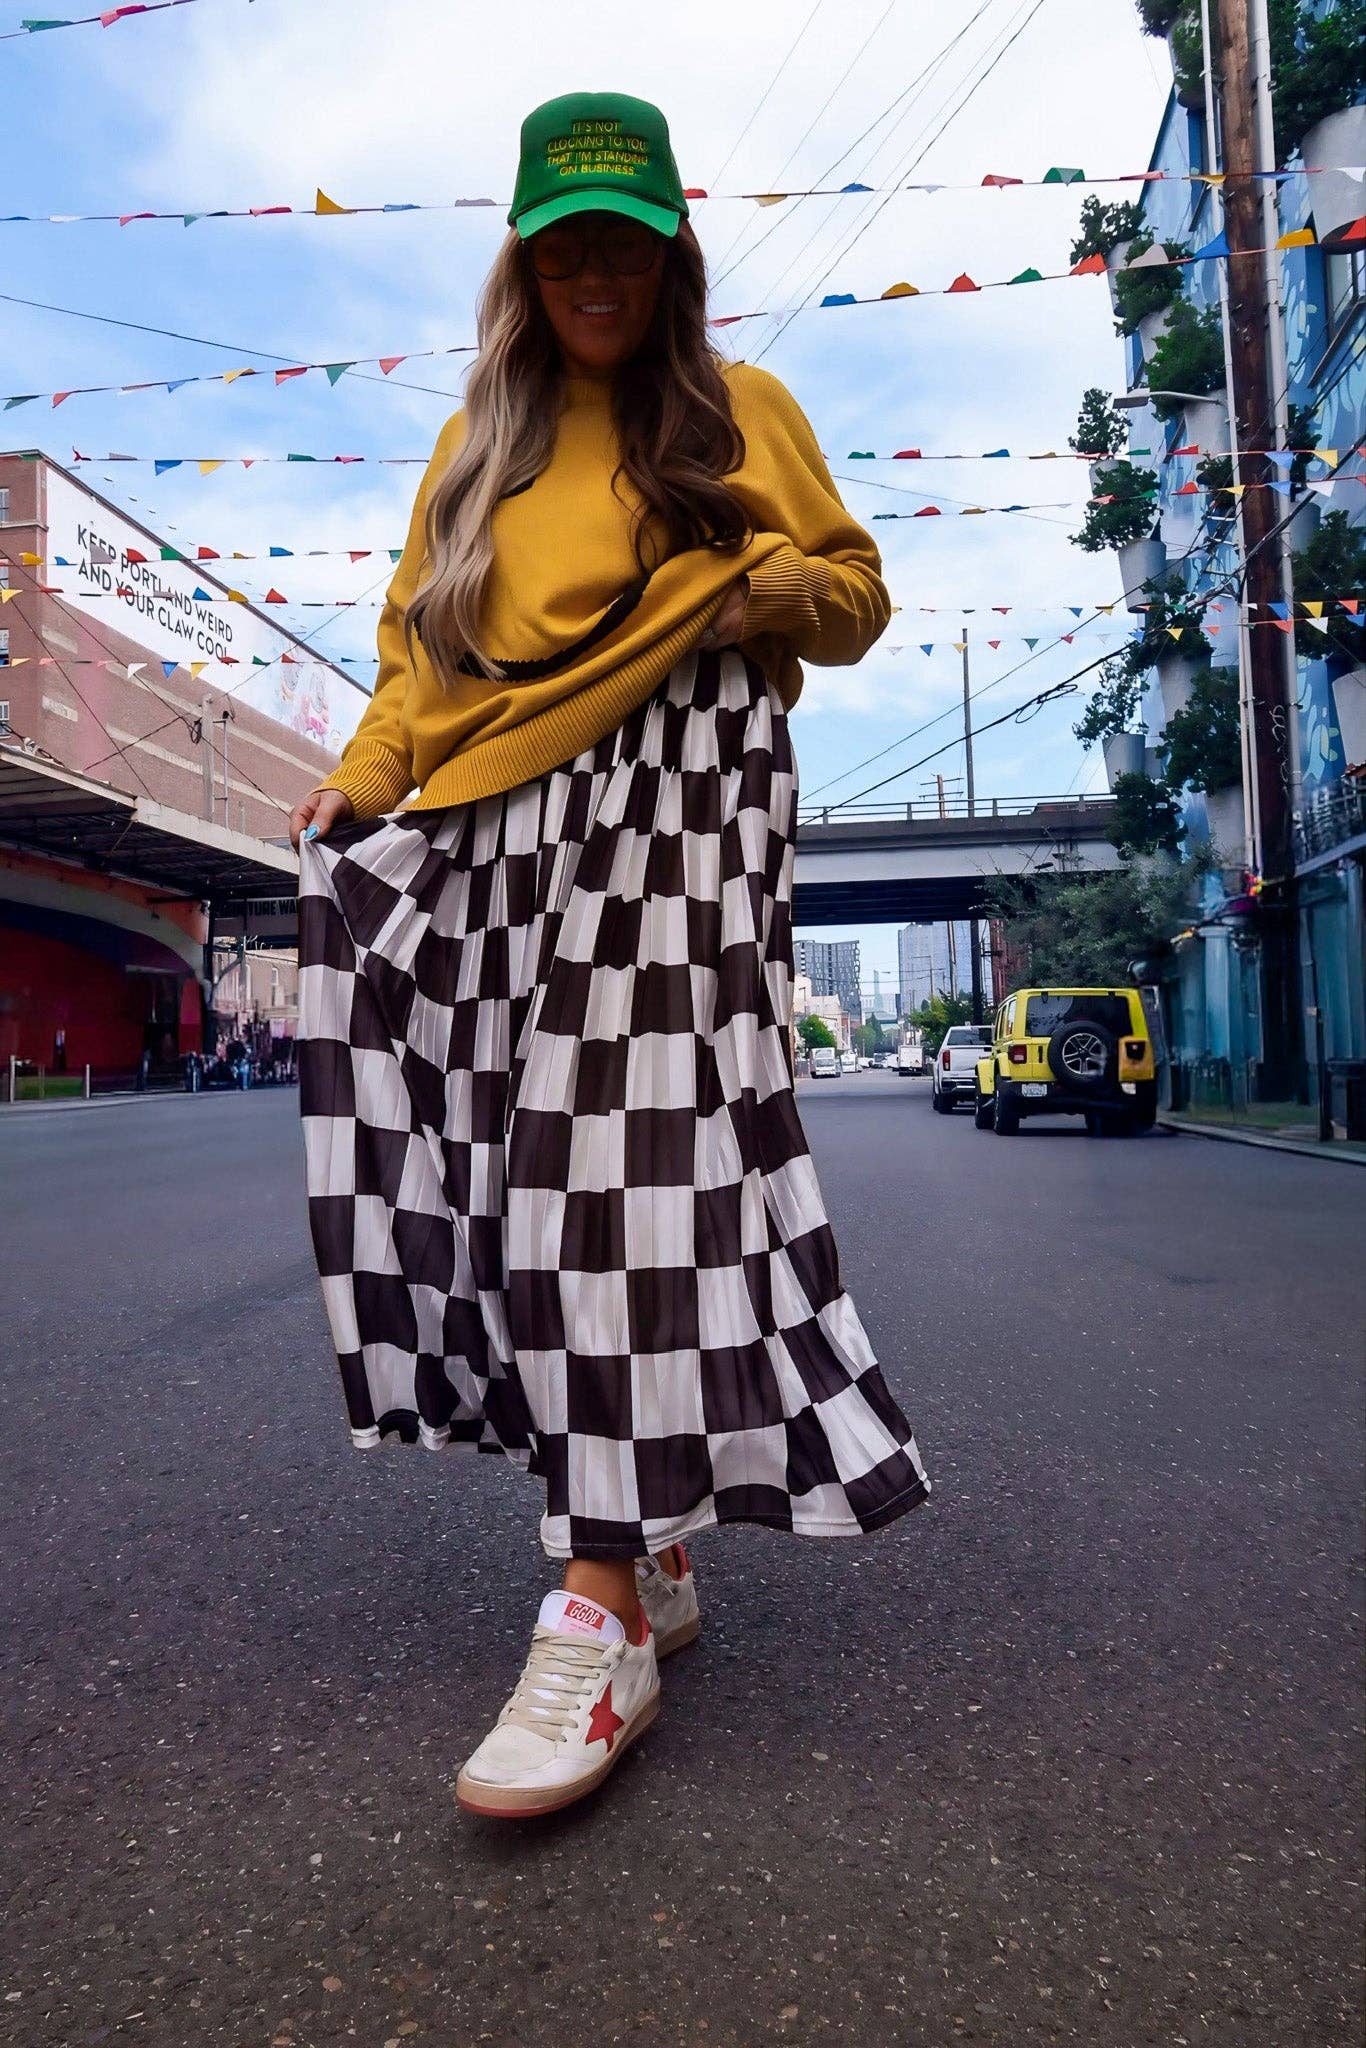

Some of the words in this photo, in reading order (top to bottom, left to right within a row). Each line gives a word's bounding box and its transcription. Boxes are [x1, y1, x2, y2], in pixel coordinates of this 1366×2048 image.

[573, 122, 592, 134] IT'S
[595, 121, 618, 133] NOT
[548, 135, 604, 153] CLOCKING
[609, 135, 623, 147] TO
[626, 137, 648, 152] YOU
[547, 152, 571, 167] THAT
[576, 151, 592, 163] I'M
[595, 150, 648, 165] STANDING
[559, 165, 577, 176] ON
[77, 557, 112, 592] AND
[116, 577, 155, 620] YOUR
[158, 609, 194, 641] CLAW
[121, 552, 192, 616] PORTLAND
[195, 602, 233, 643] WEIRD
[569, 1603, 601, 1625] GGDB
